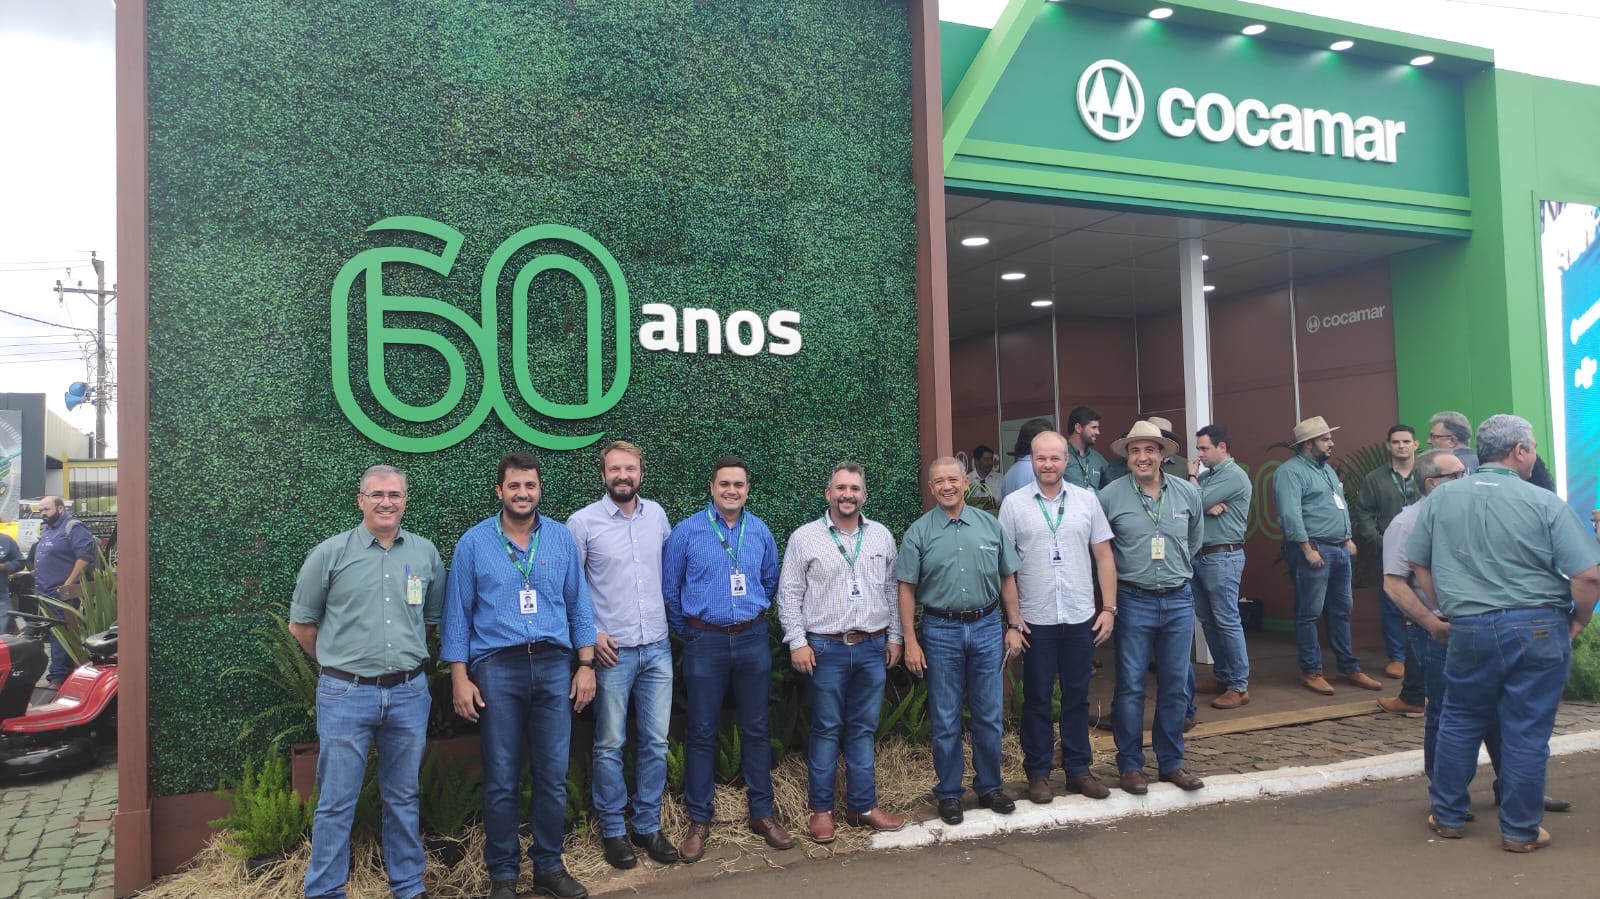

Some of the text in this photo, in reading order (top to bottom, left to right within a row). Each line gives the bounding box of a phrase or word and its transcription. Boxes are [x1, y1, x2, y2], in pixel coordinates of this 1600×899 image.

[1157, 87, 1406, 164] cocamar
[330, 215, 803, 453] 60 anos
[1322, 305, 1386, 328] cocamar
